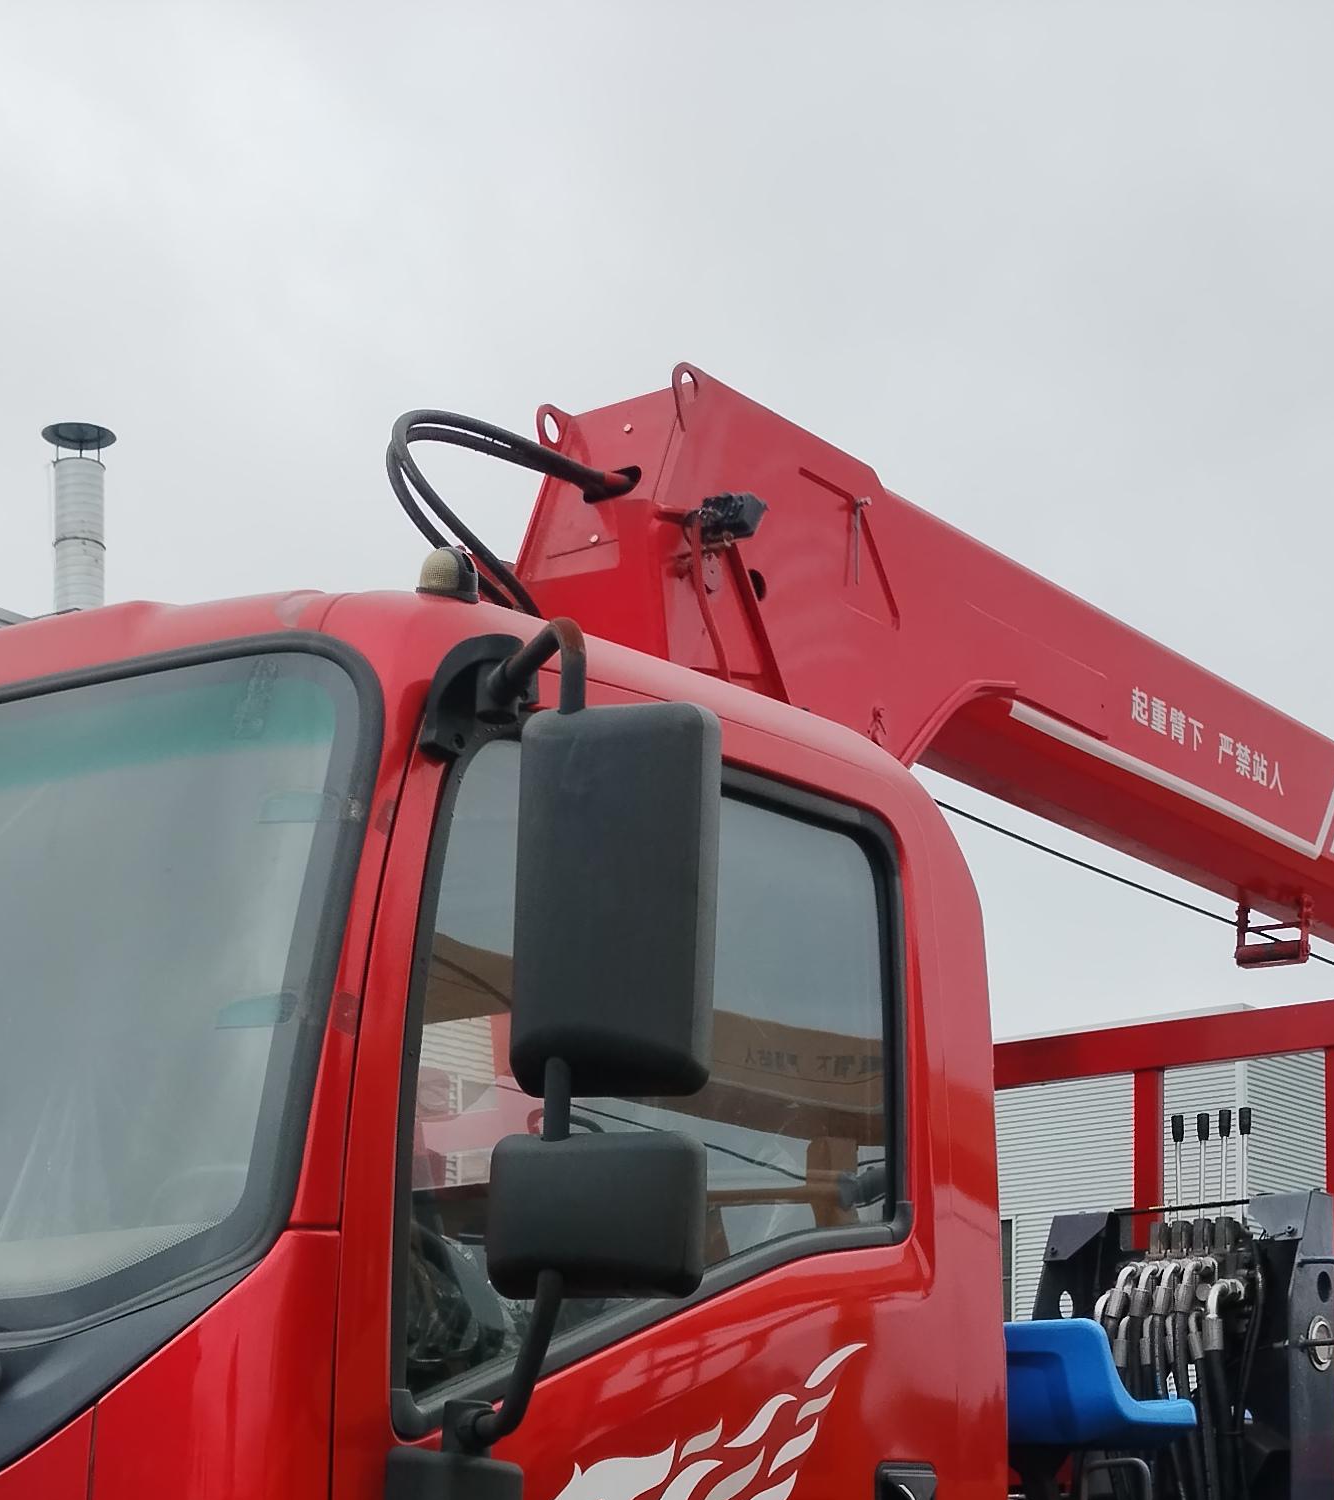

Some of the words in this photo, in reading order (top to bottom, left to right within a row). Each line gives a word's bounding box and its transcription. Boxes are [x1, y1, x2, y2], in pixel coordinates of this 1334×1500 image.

[1131, 686, 1204, 751] 起重臂下
[1218, 732, 1284, 796] 严禁站人
